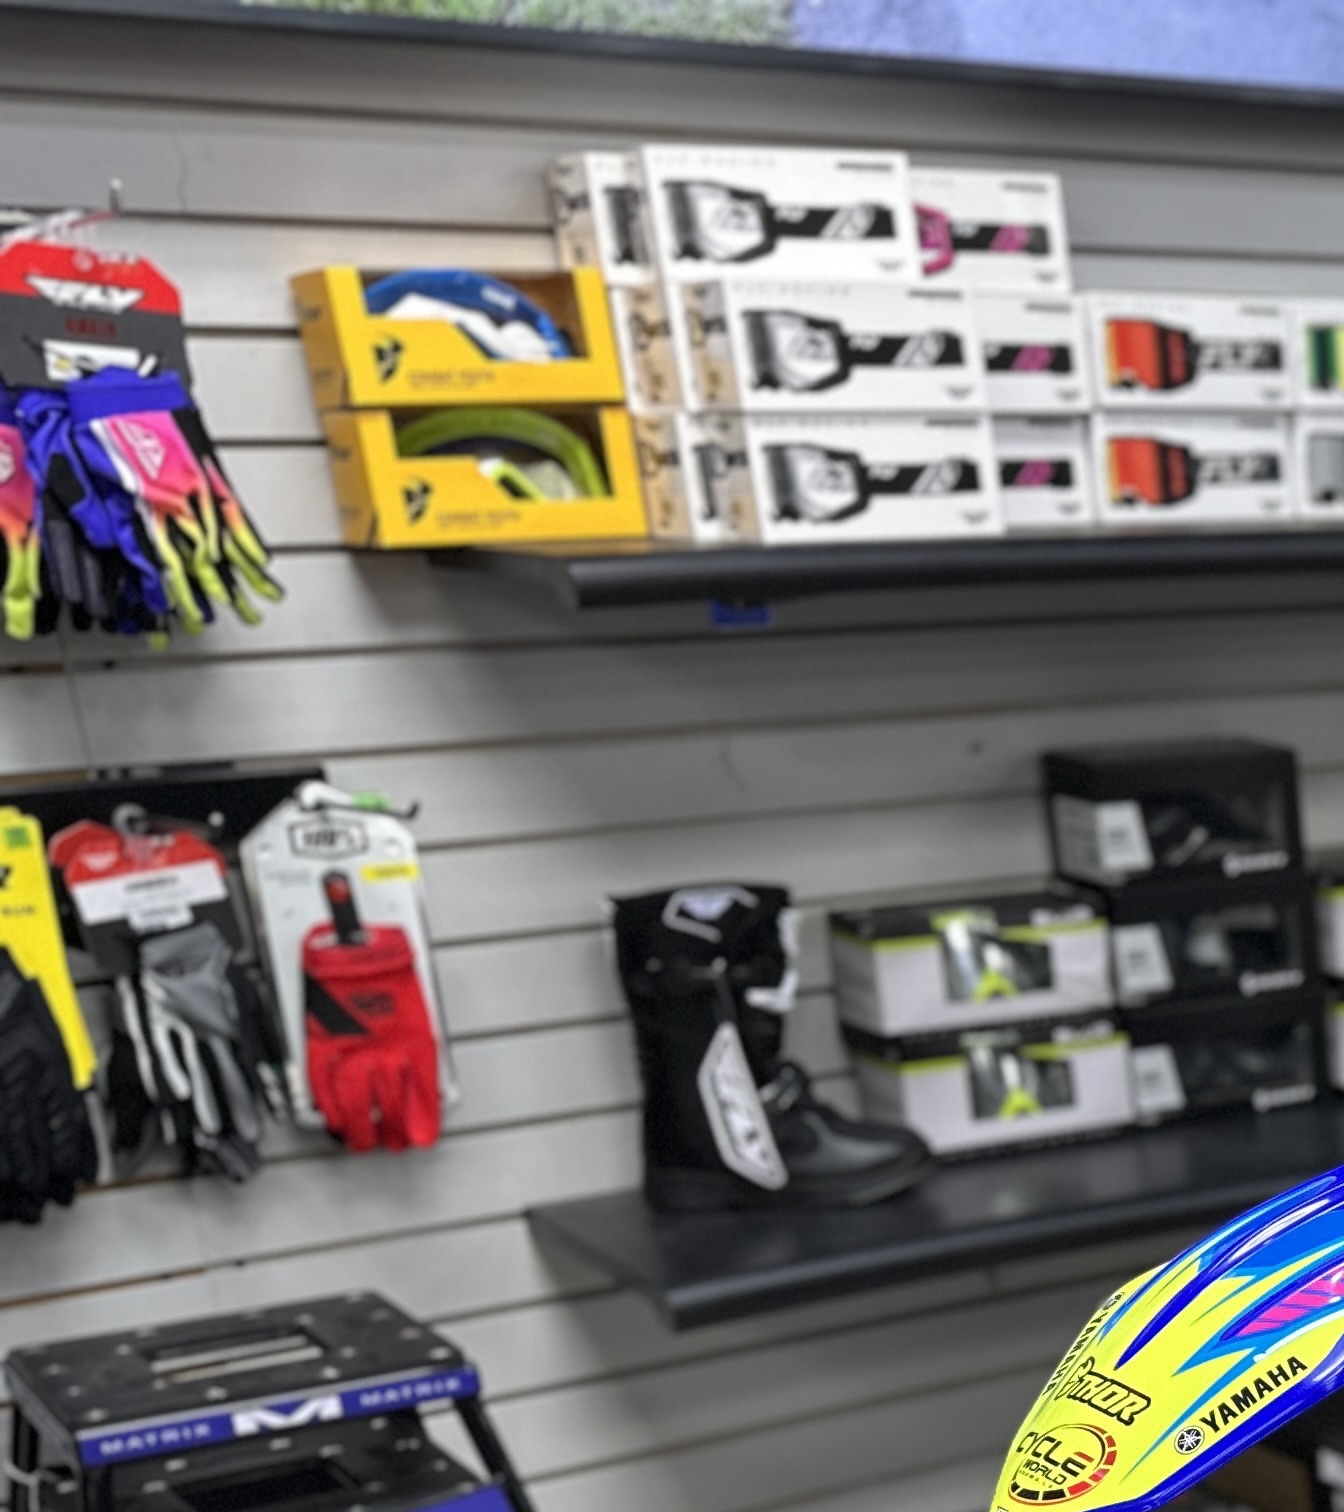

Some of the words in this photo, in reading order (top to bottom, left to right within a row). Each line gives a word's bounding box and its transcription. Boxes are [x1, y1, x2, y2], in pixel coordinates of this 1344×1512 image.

[99, 1421, 211, 1456] MATRIX
[359, 1376, 461, 1407] MATRIX
[1066, 1370, 1152, 1427] THOR
[1199, 1356, 1308, 1433] YAMAHA
[1016, 1431, 1095, 1478] CYCLE
[1023, 1459, 1067, 1485] WORLD
